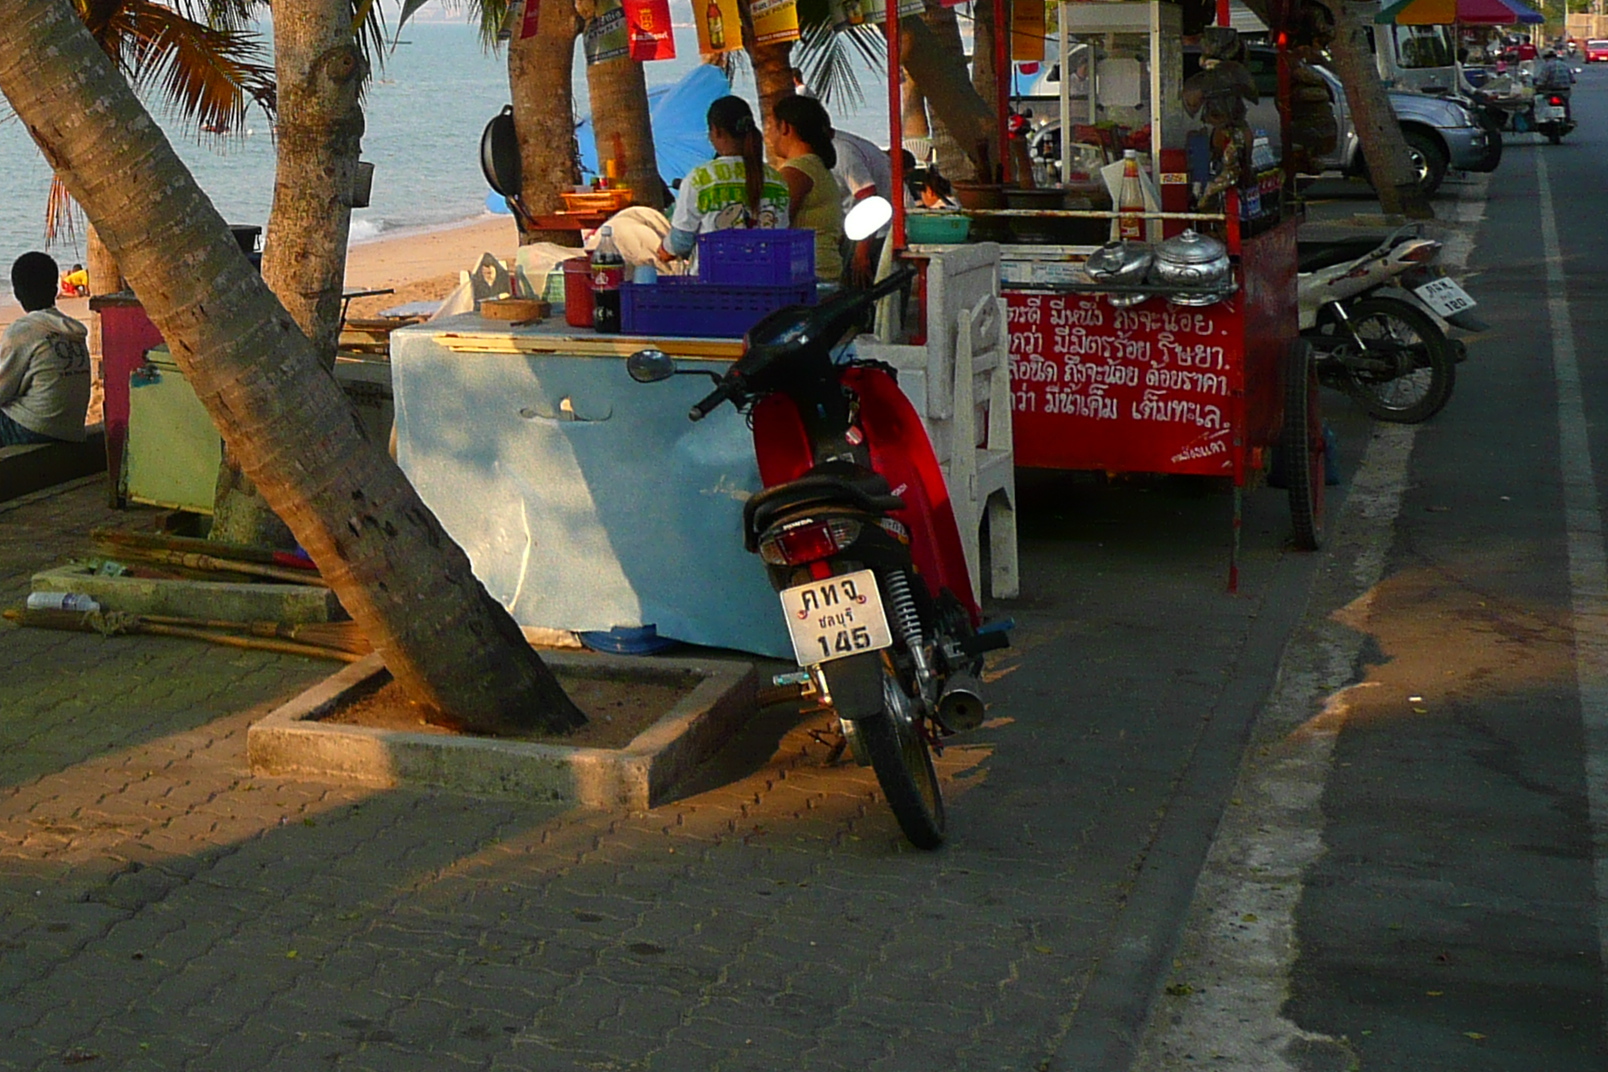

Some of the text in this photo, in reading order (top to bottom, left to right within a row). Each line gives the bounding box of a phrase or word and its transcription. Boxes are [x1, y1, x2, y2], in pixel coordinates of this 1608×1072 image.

[1444, 298, 1468, 311] 120
[818, 607, 854, 628] ชลบุรี
[817, 626, 872, 657] 145
